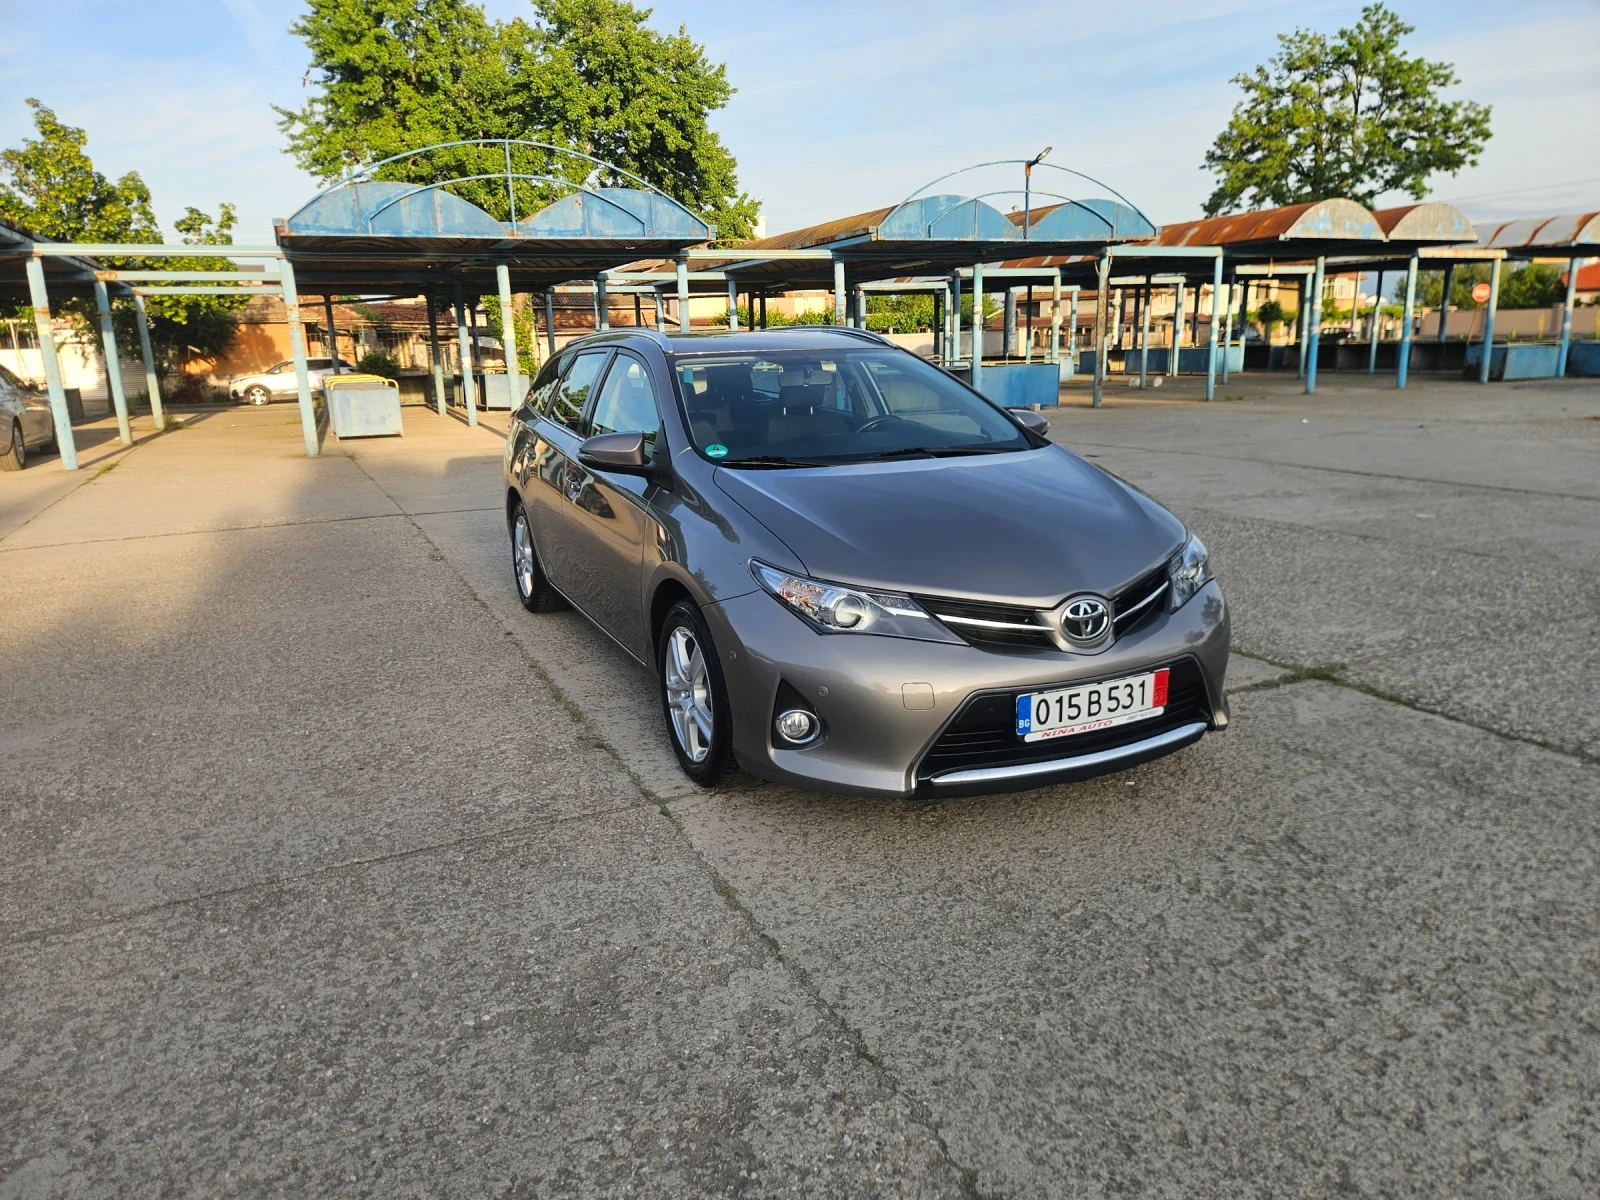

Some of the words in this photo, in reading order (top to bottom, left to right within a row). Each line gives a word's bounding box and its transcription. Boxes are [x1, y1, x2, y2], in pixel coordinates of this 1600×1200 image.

[1018, 720, 1030, 728] BG
[1042, 728, 1074, 738] NINA
[1078, 720, 1112, 731] AUTO
